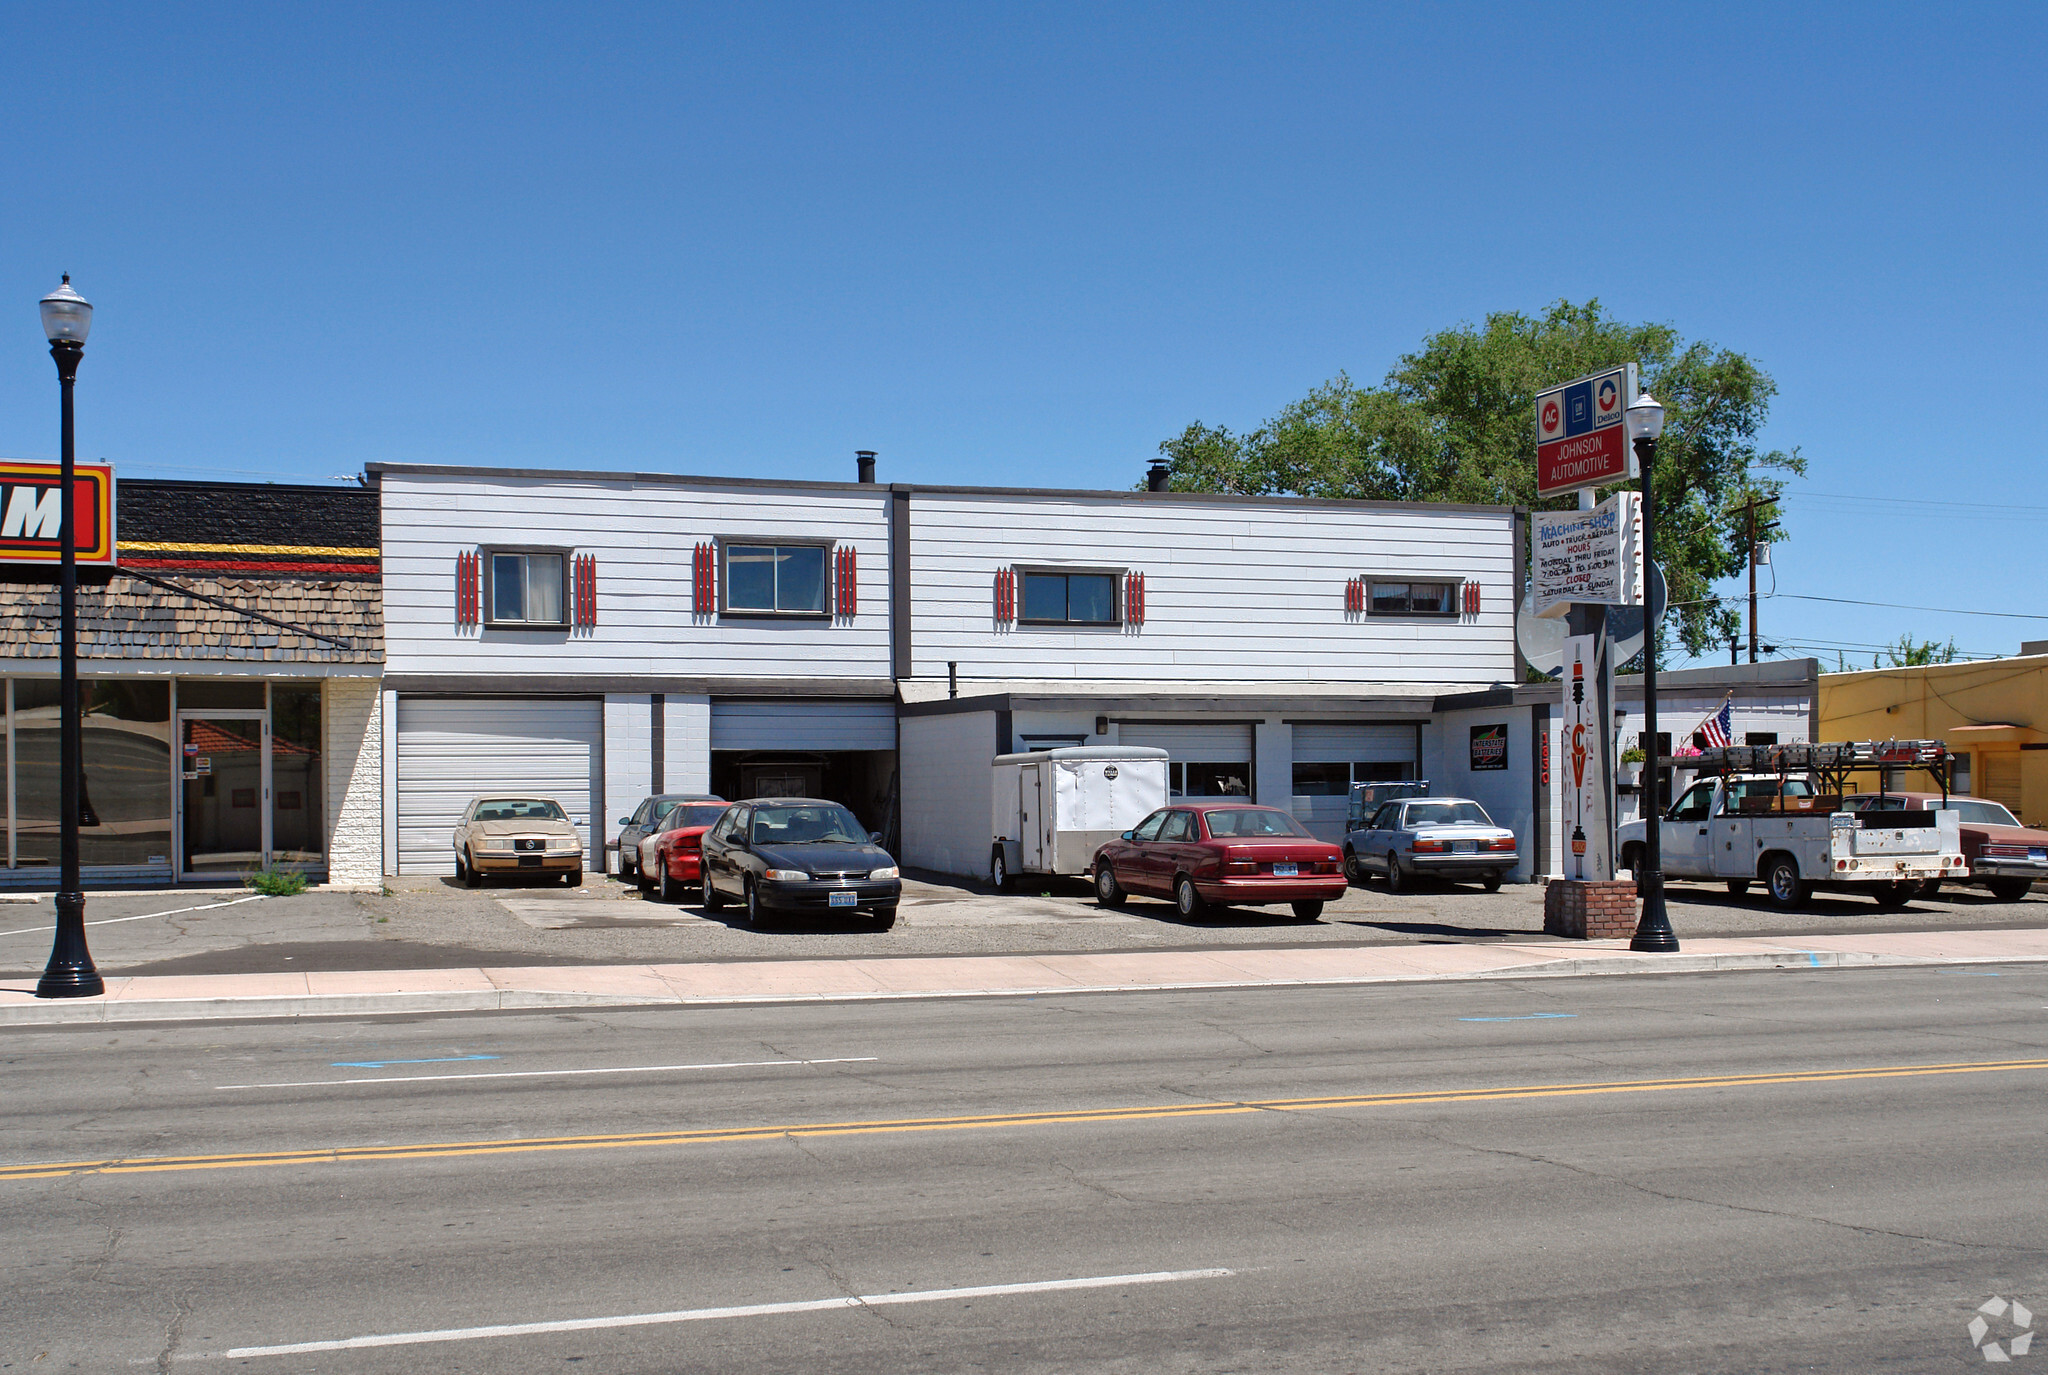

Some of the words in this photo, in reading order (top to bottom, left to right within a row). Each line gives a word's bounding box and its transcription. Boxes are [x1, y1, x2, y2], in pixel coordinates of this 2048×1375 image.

[1544, 408, 1557, 425] AC
[1597, 411, 1620, 424] Delco
[1557, 435, 1603, 461] JOHNSON
[1551, 453, 1610, 481] AUTOMOTIVE
[0, 485, 62, 539] M
[1540, 522, 1585, 541] MACHINE
[1589, 511, 1616, 530] SHOP
[1542, 539, 1560, 549] AUTO
[1566, 533, 1585, 544] TRUCK
[1591, 529, 1614, 539] REPAIR
[1567, 543, 1591, 554] HOURS
[1541, 557, 1572, 568] MONDAY
[1574, 552, 1591, 562] THRU
[1593, 548, 1615, 557] FRIDAY
[1561, 566, 1572, 574] AM
[1576, 564, 1585, 573] TO
[1566, 572, 1592, 585] CLOSED
[1542, 585, 1575, 597] SATURDAY
[1587, 579, 1614, 590] SUNDAY
[1473, 739, 1504, 747] INTERSTATE
[1474, 748, 1502, 756] BATTERIES
[1542, 732, 1550, 784] 1830
[1571, 723, 1587, 788] CV
